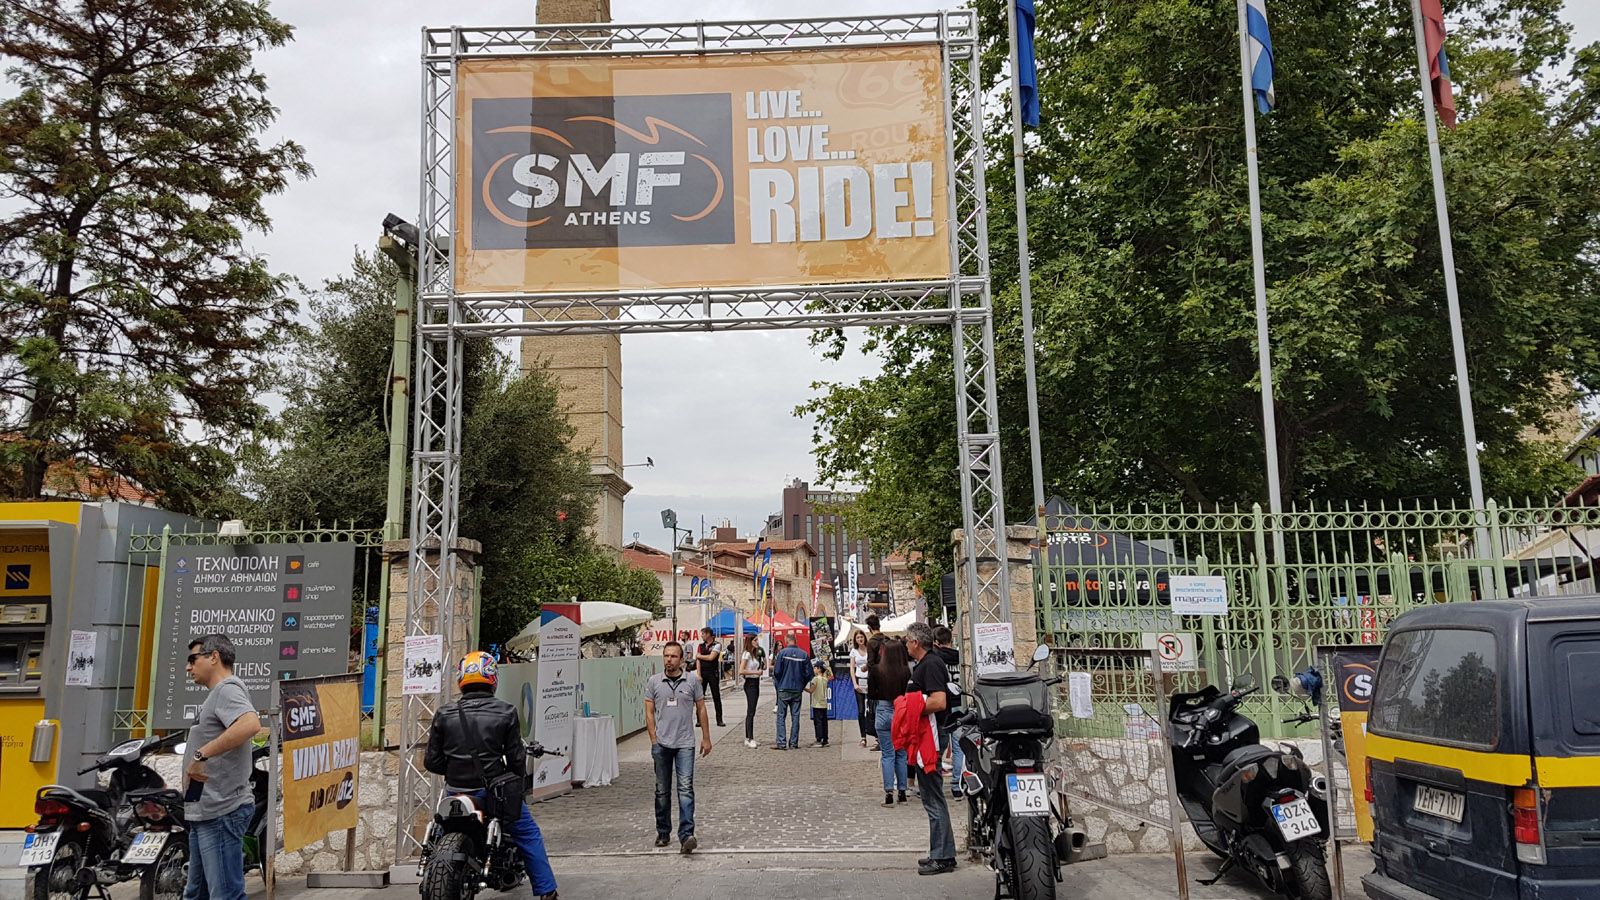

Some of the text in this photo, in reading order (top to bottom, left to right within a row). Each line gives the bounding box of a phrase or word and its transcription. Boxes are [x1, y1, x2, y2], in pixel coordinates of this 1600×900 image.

[746, 90, 822, 120] LIVE...
[748, 125, 856, 162] LOVE...
[507, 151, 686, 209] SMF
[749, 161, 934, 244] RIDE!
[564, 209, 651, 226] ATHENS
[195, 555, 279, 571] ΤΕΧΝΟΠΟΛΗ
[194, 572, 278, 584] ΔΗΜΟΥ ΑΘΗΝΑΙΩΝ
[850, 560, 859, 601] SUZUKI
[193, 586, 230, 594] TECHNOPOLIS
[191, 608, 276, 624] ΒΙΟΜΗΧΑΝΙΚΟ
[190, 624, 274, 635] ΜΟΥΣΕΙΟ ΦΩΤΑΕΡΙΟΥ
[244, 637, 274, 646] MUSEUM
[233, 663, 271, 677] THENS
[291, 705, 316, 727] SMF
[1290, 818, 1318, 835] 340
[31, 849, 53, 862] 113
